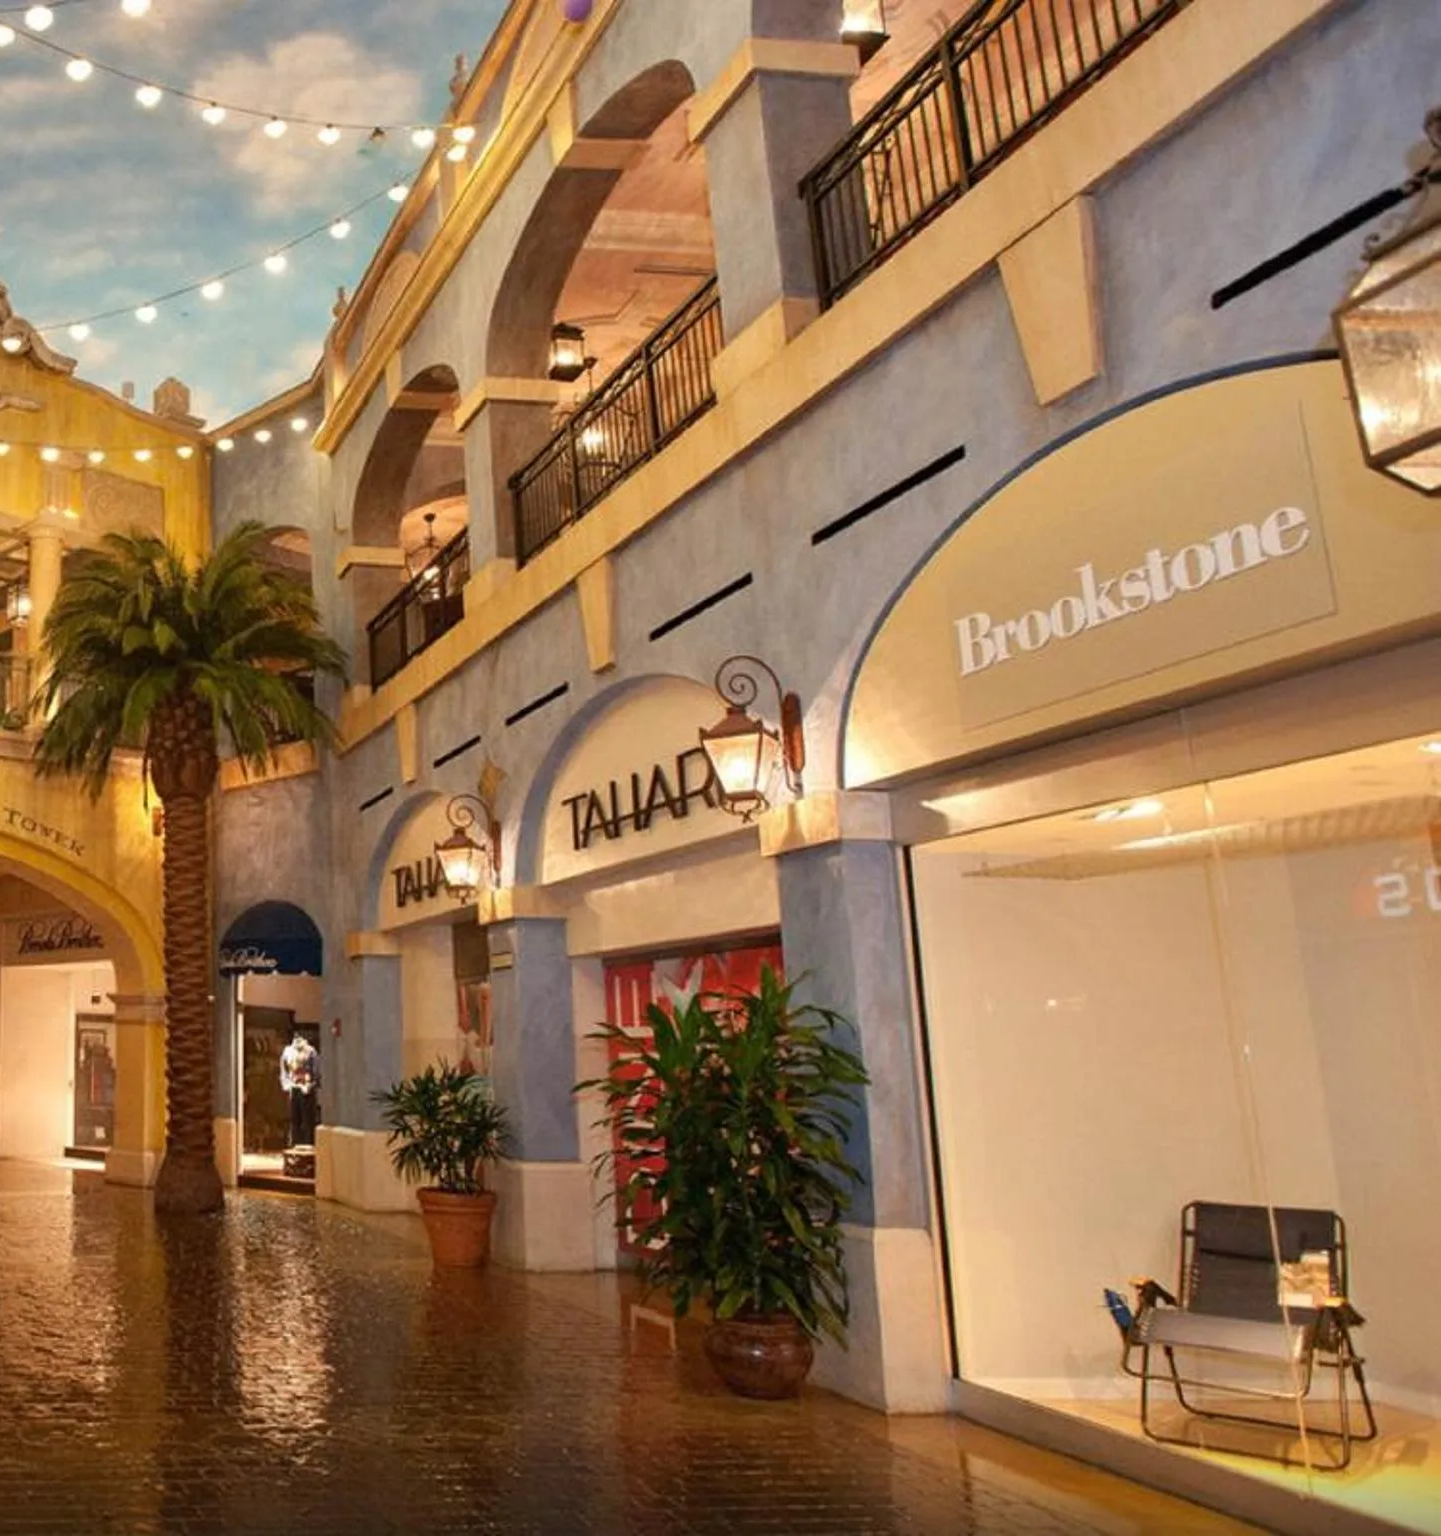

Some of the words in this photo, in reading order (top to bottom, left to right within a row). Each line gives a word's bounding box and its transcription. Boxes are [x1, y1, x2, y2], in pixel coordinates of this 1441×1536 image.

[954, 505, 1311, 677] Brookstone
[561, 747, 716, 851] TAHAR
[391, 857, 448, 908] TAHA
